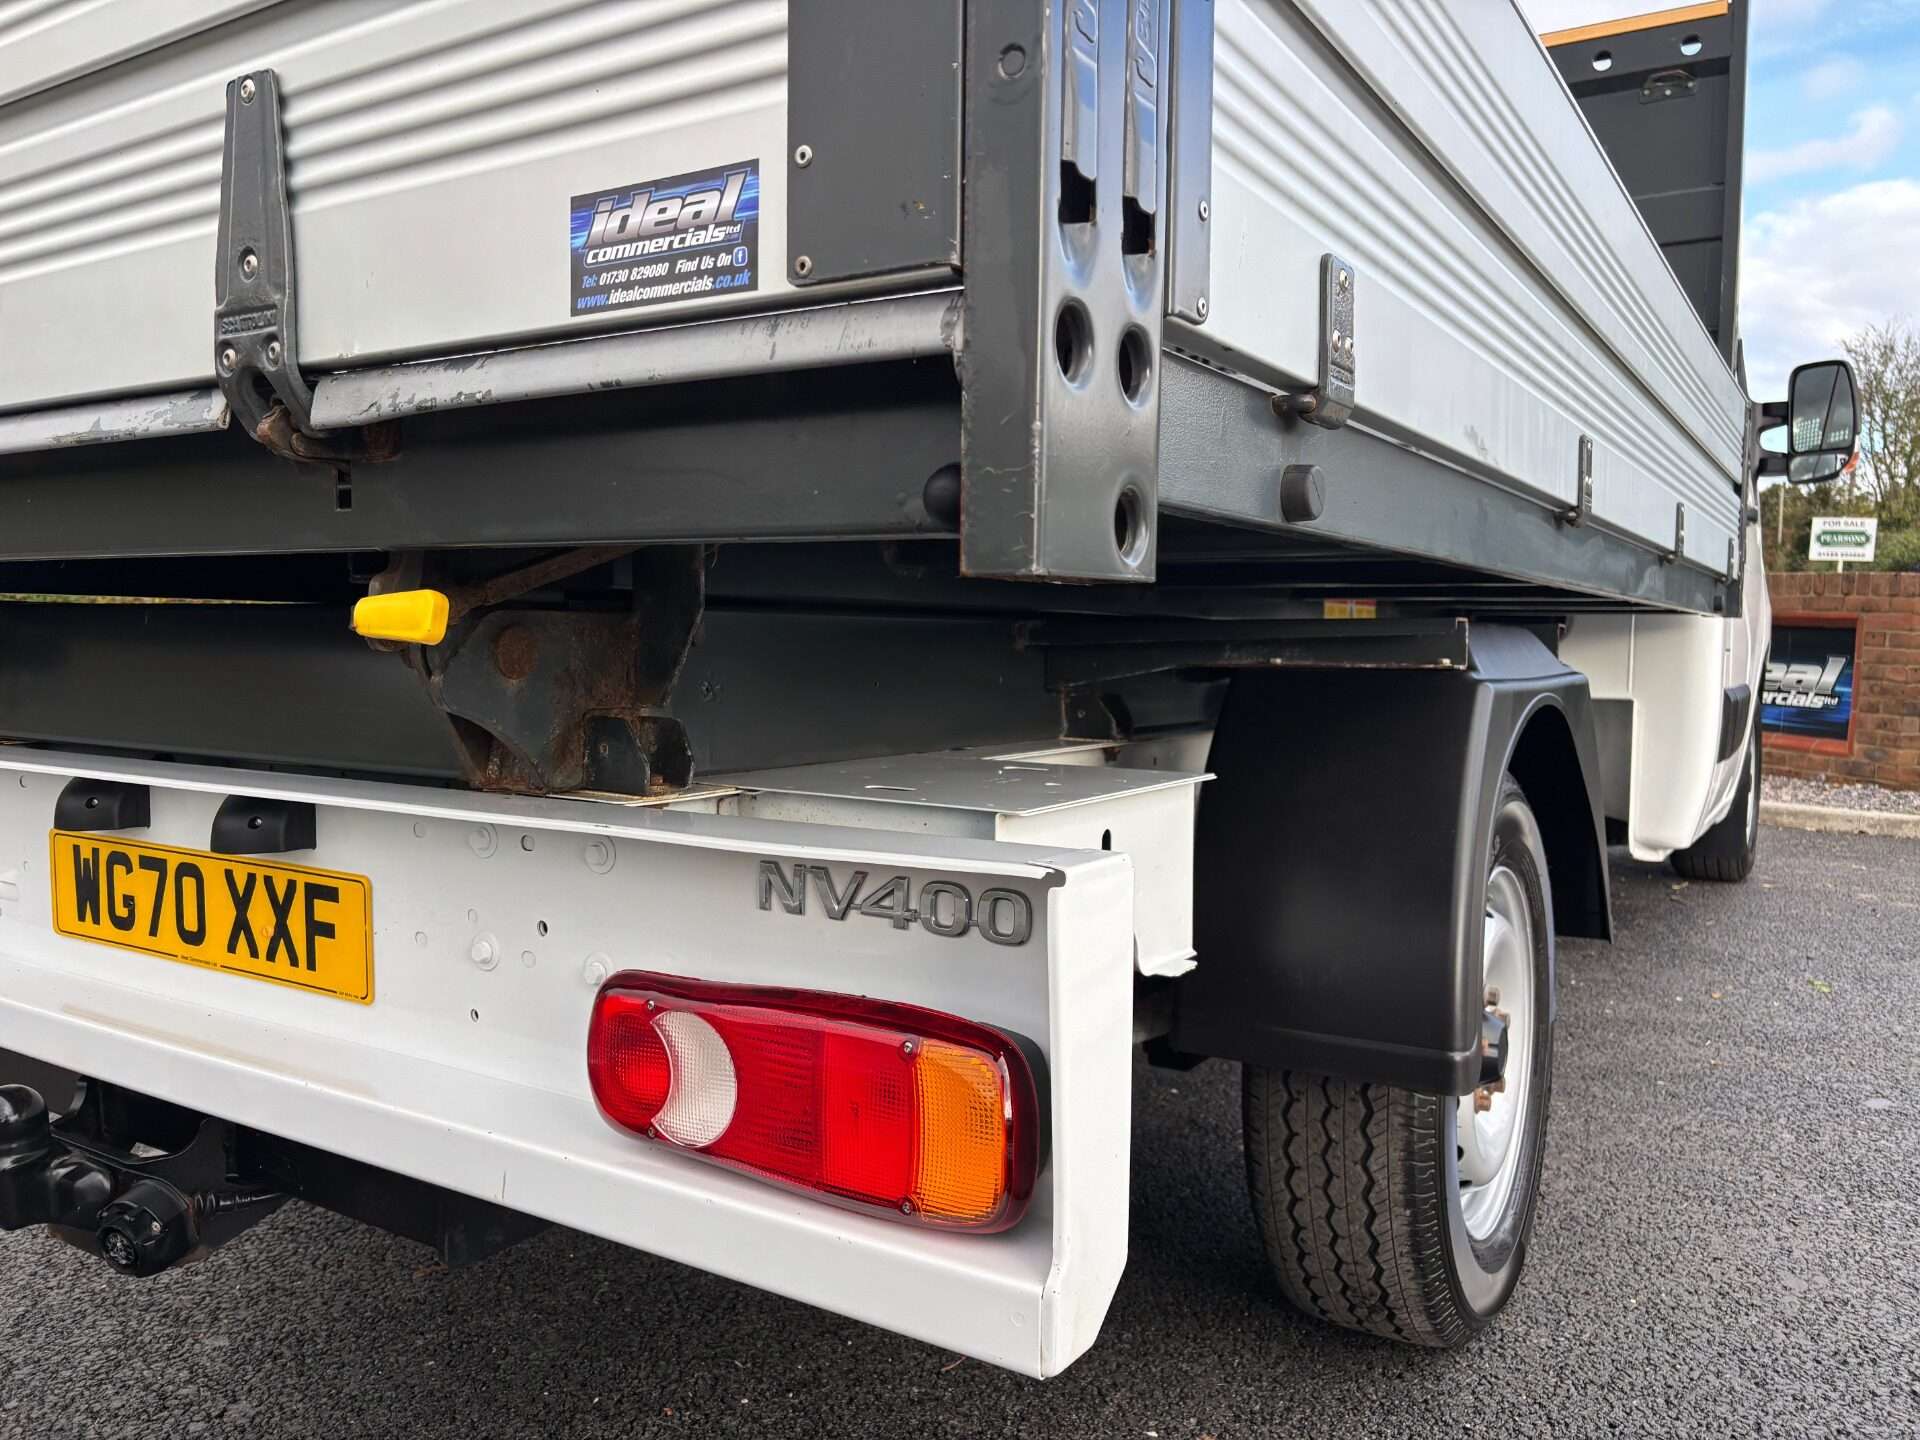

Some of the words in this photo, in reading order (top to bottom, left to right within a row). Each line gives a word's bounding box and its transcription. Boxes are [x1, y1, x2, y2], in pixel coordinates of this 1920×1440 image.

[586, 173, 746, 248] ideal
[582, 275, 598, 289] Tel:
[599, 268, 629, 286] 01730
[630, 262, 670, 281] 829080
[675, 258, 698, 274] Find
[700, 256, 715, 270] Us
[716, 252, 732, 267] On
[586, 224, 726, 264] commercials
[726, 224, 741, 235] ltd
[576, 269, 752, 310] www.idealcommercials.co.uk
[72, 844, 206, 947] WG70
[224, 868, 340, 973] XXF
[759, 860, 1032, 947] NV400
